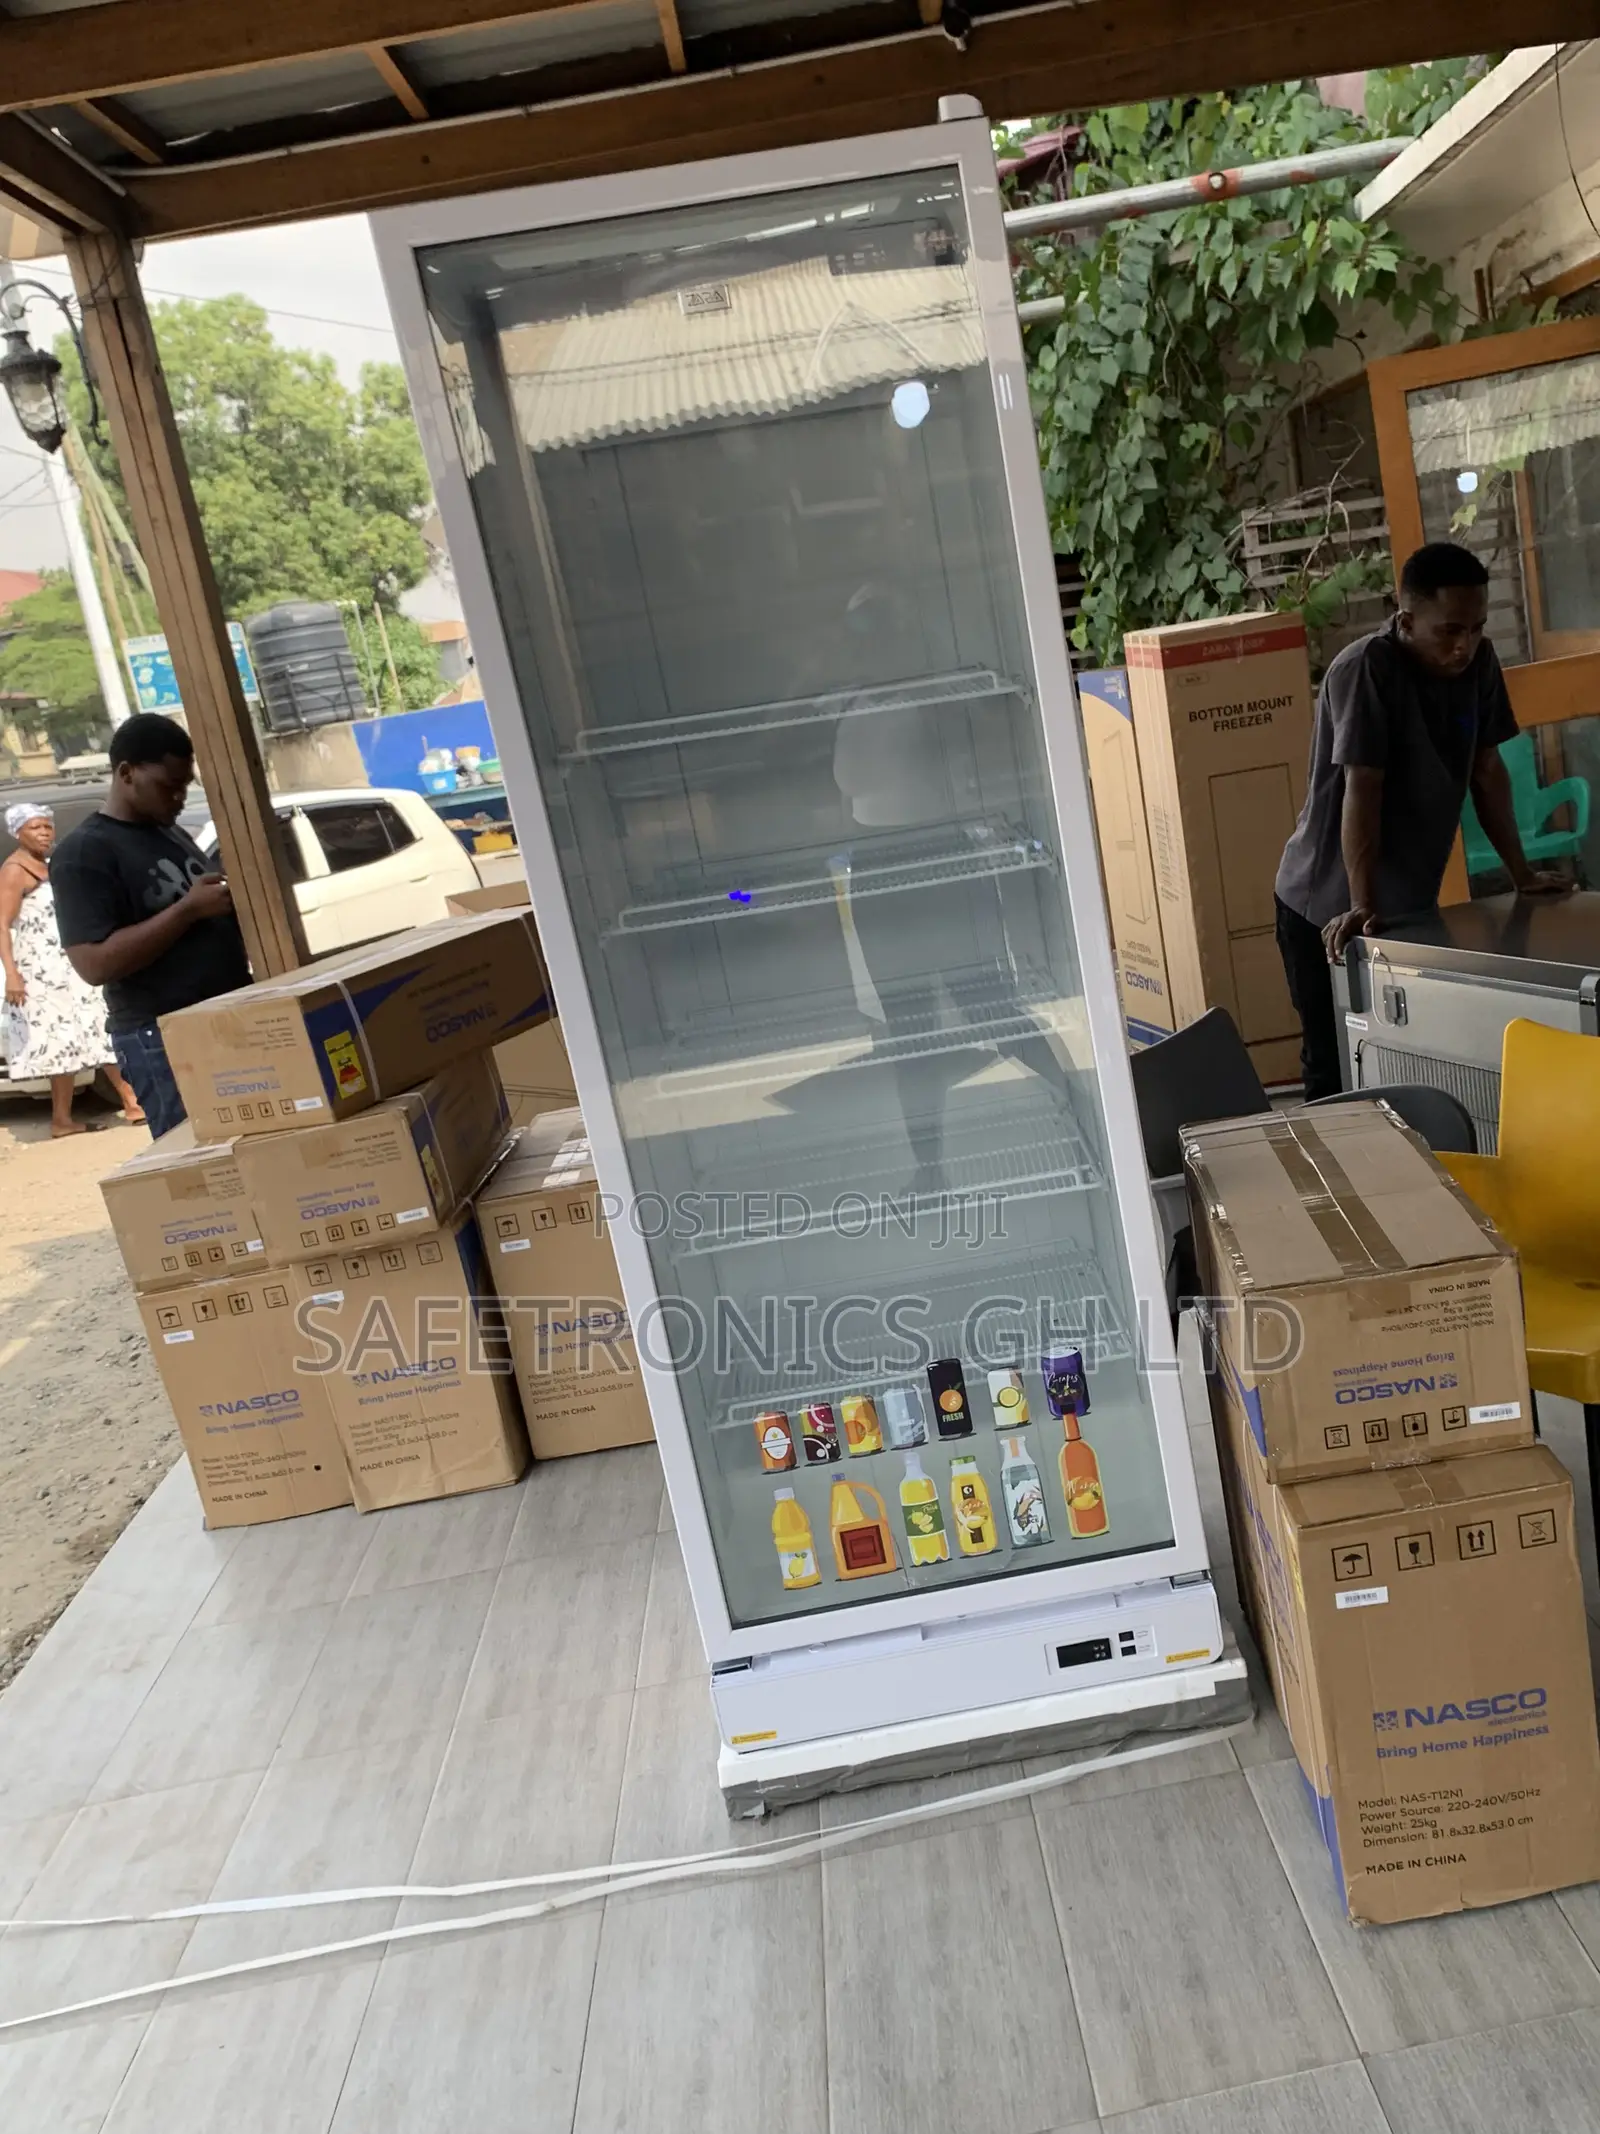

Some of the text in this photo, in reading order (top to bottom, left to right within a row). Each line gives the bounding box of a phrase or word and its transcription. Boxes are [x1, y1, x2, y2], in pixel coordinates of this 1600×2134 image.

[1188, 695, 1294, 723] BOTTOM MOUNT
[1213, 712, 1273, 732] FREEZER
[300, 1198, 366, 1220] NASCO
[164, 1225, 225, 1245] NASCO
[1429, 1279, 1491, 1294] MADE IN CHINA
[370, 1356, 457, 1385] NASCO
[1332, 1352, 1455, 1377] Bring Home Happiness
[1335, 1375, 1436, 1405] NASCO
[216, 1389, 299, 1416] NASCO
[536, 1412, 560, 1421] MADE
[571, 1405, 596, 1415] CHINA
[942, 1411, 965, 1423] FRESH
[360, 1454, 421, 1473] MADE IN CHINA
[211, 1495, 233, 1503] MADE
[243, 1490, 269, 1499] CHINA
[1404, 1687, 1547, 1728] NASCO
[1488, 1708, 1548, 1726] electronics
[1376, 1724, 1550, 1760] Bring Home Happiness
[1357, 1788, 1464, 1810] Model: NAS-T12N1
[1359, 1787, 1541, 1823] Power Source: 220-240V/50Hz
[1361, 1818, 1437, 1835] Weight: 25kg
[1363, 1832, 1428, 1848] Dimension:
[1517, 1815, 1534, 1826] cm
[1365, 1853, 1468, 1876] MADE IN CHINA
